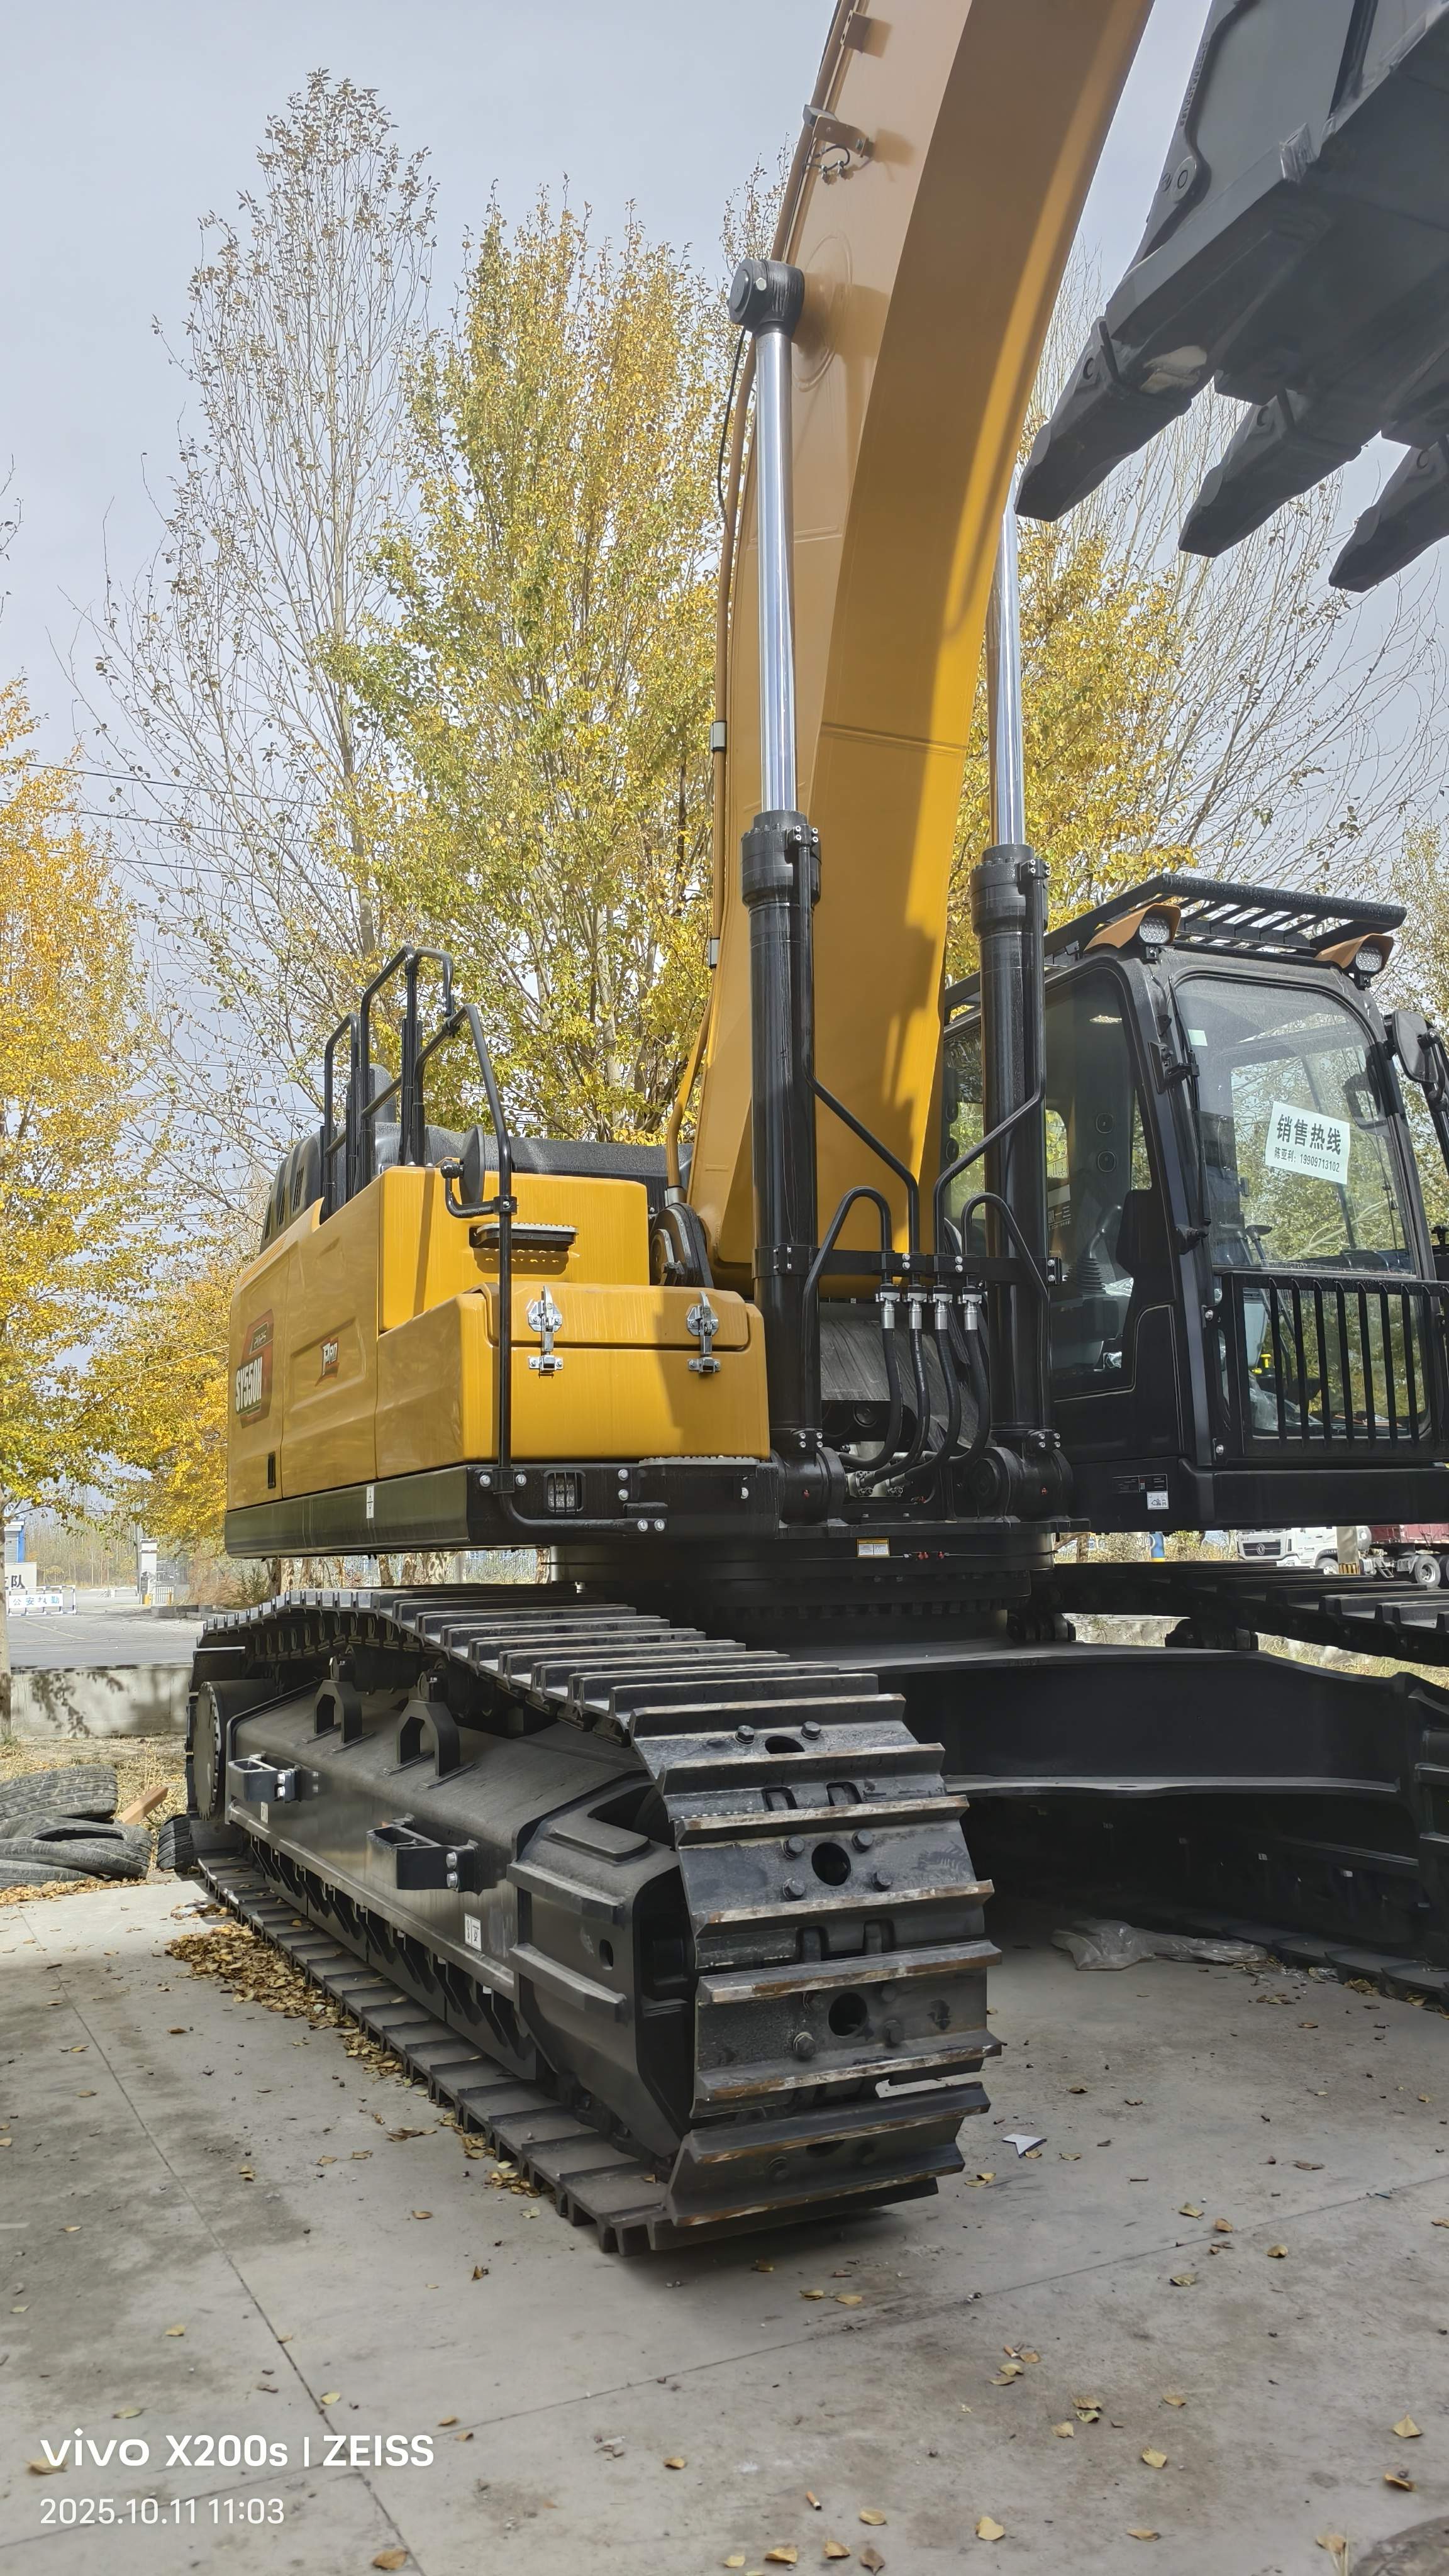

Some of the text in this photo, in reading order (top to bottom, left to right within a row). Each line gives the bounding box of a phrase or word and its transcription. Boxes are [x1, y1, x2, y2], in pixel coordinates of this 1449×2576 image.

[1276, 1114, 1341, 1155] 销售热线
[236, 1357, 263, 1412] SY550H
